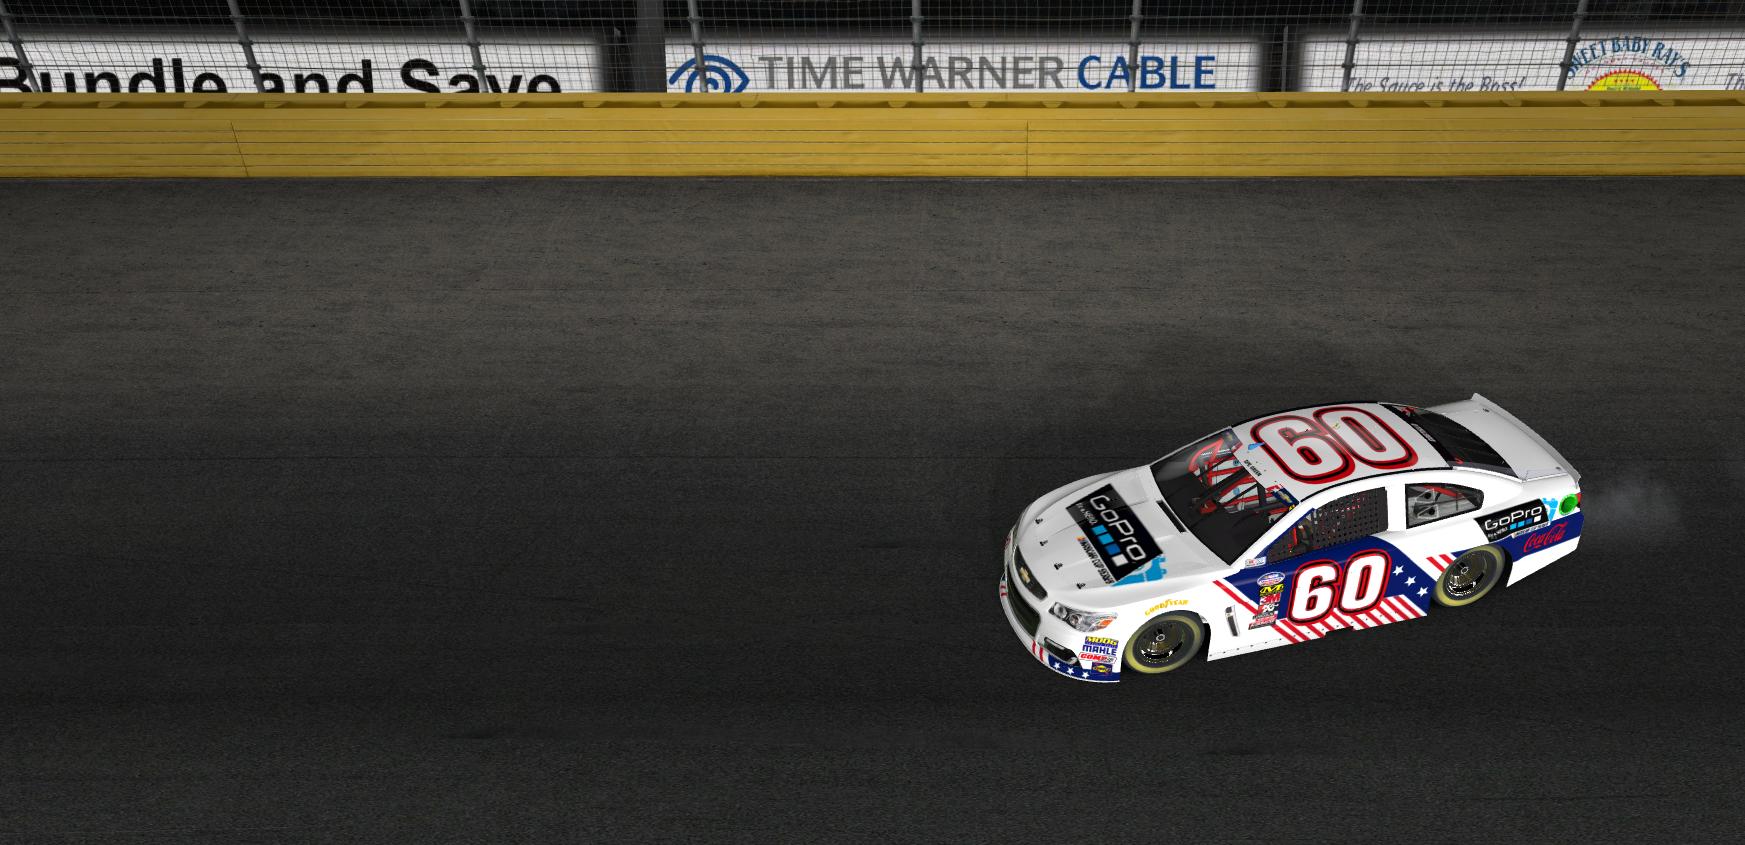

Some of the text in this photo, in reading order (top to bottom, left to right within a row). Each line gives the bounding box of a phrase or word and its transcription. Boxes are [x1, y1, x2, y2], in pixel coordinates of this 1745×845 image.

[1611, 36, 1649, 54] BABY
[256, 59, 374, 93] and
[758, 55, 1216, 89] TIME WARNER CABLE
[1250, 406, 1418, 484] 60
[1090, 495, 1146, 560] GoPro
[1484, 506, 1543, 531] GoPro
[1287, 548, 1392, 626] 60
[1082, 644, 1118, 656] MAHLE
